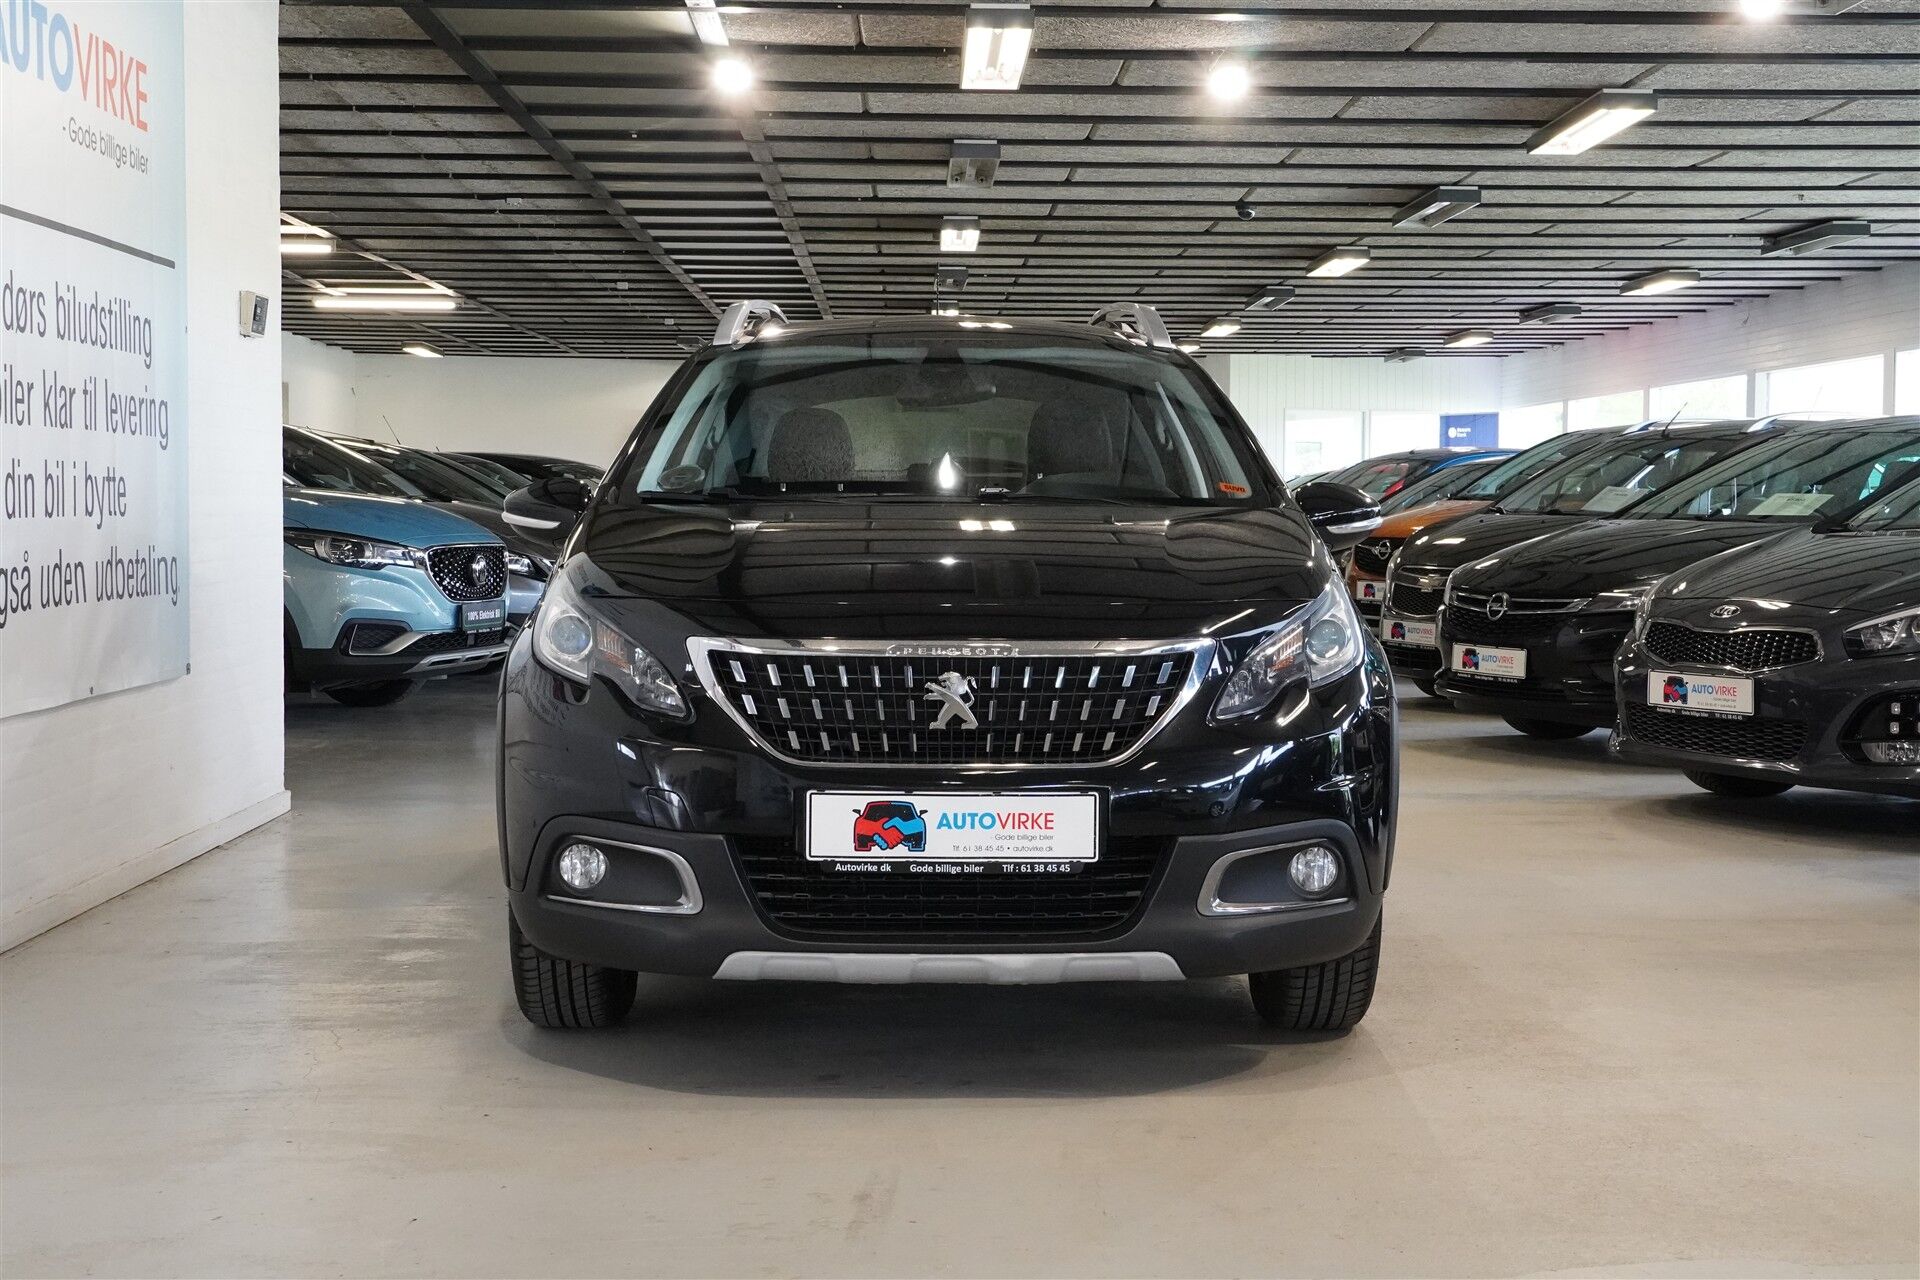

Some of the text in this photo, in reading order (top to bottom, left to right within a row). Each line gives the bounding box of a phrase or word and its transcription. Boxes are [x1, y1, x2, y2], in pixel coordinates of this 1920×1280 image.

[68, 116, 97, 151] Gode
[99, 130, 128, 169] billige
[129, 149, 149, 175] biler
[2, 269, 152, 370] dørs biludstilling
[0, 363, 169, 450] iler klar til levering
[4, 458, 127, 530] din bil i bytte
[41, 548, 87, 610] uden
[96, 545, 178, 607] udbetaling
[1481, 654, 1514, 665] AUTOVIRKE
[1691, 683, 1738, 697] AUTOVIRKE
[936, 812, 1055, 830] AUTOVIRKE
[1017, 833, 1037, 842] billige
[1039, 833, 1054, 841] biler
[835, 863, 878, 872] Autovirke
[910, 864, 933, 873] Gode
[935, 864, 961, 874] billige
[963, 864, 984, 873] biler
[1020, 864, 1032, 873] 61
[1033, 864, 1045, 873] 38
[1046, 864, 1058, 873] 45
[1059, 864, 1071, 873] 45
